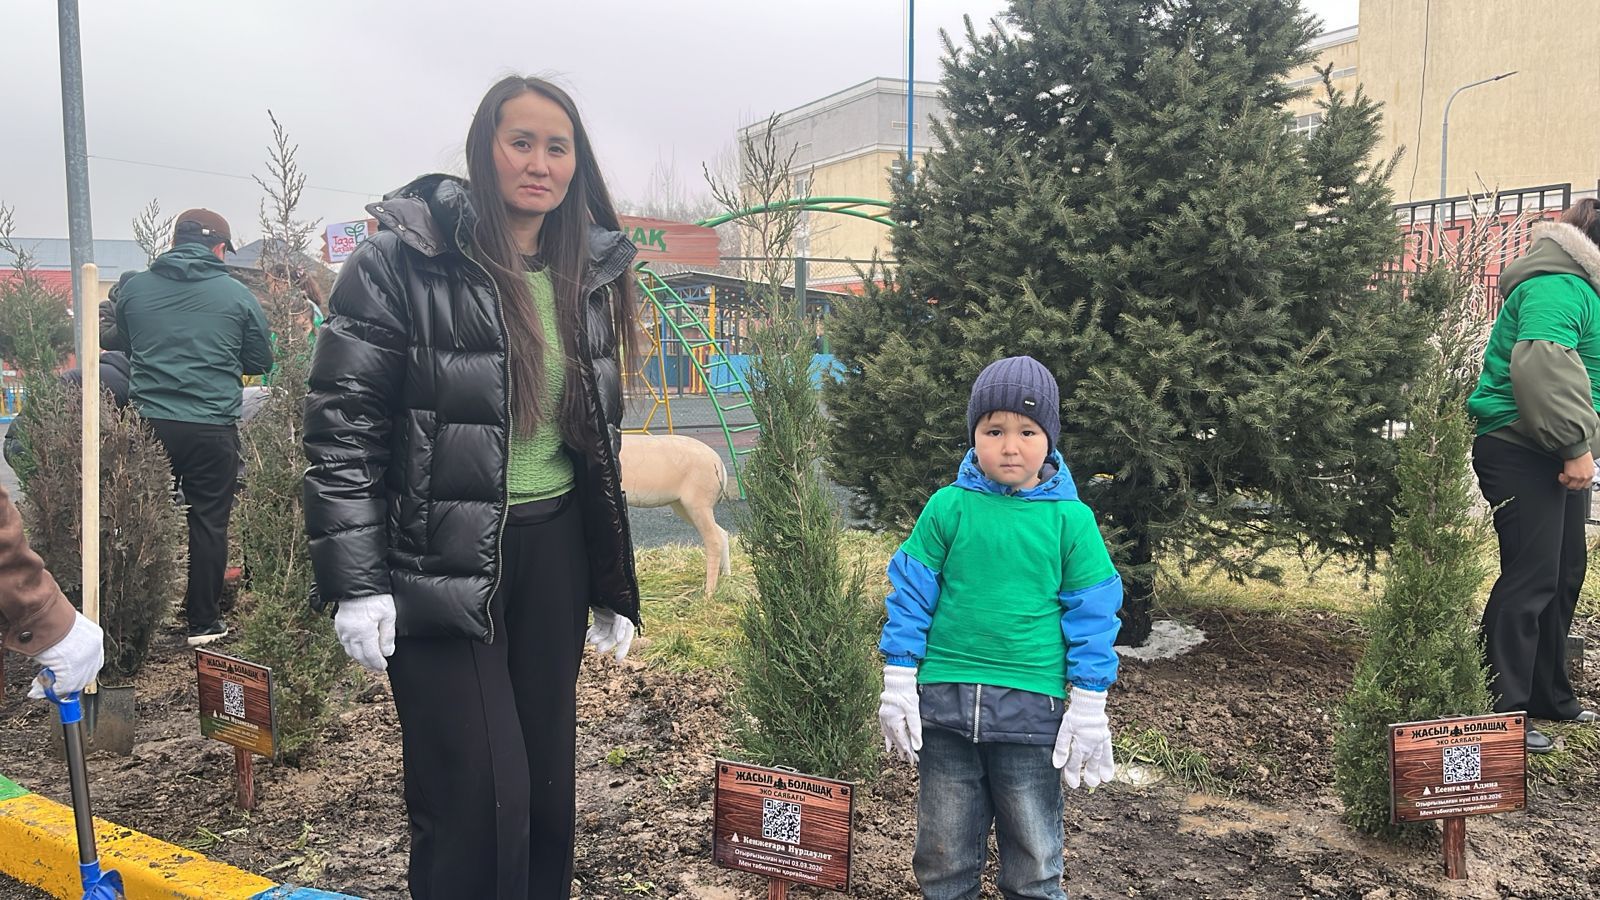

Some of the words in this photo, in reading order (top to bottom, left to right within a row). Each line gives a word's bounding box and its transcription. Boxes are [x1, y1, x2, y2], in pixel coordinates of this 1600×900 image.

[332, 236, 354, 247] Таза
[1411, 726, 1449, 739] ЖАСЫЛ
[1464, 722, 1508, 732] БОЛАШАҚ
[1451, 736, 1482, 745] САЯБАҒЫ
[735, 771, 773, 785] ЖАСЫЛ
[787, 778, 833, 798] БОЛАШАҚ
[1473, 782, 1498, 791] Адина
[760, 788, 773, 796] ЭКО
[773, 790, 806, 802] САЯБАҒЫ
[1471, 793, 1502, 802] 03.03.2026
[738, 859, 752, 868] Мен
[791, 860, 823, 872] 03.03.2026
